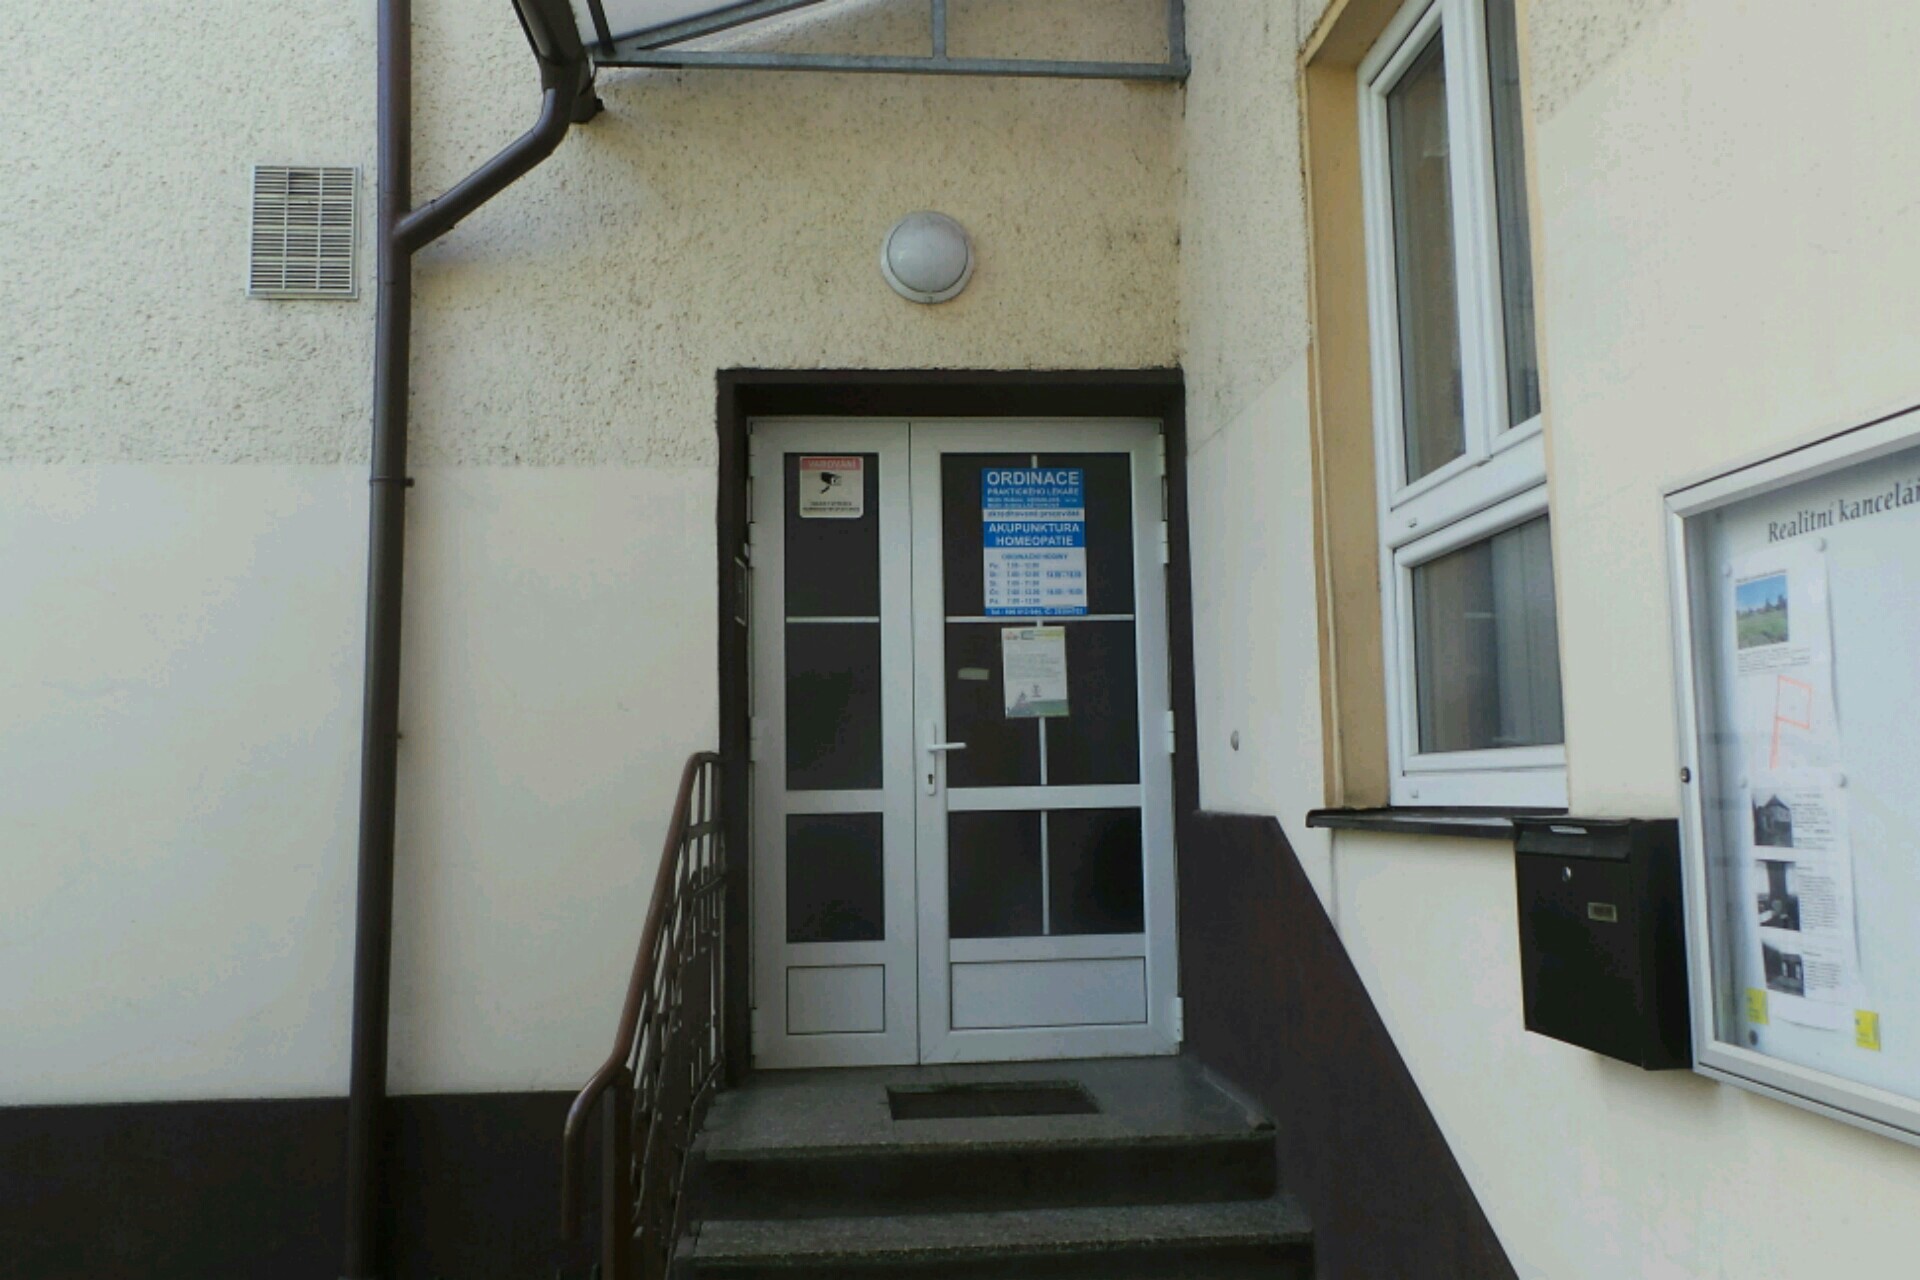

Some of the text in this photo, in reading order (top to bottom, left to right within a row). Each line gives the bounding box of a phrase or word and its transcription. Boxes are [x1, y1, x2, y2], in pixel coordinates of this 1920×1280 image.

[987, 471, 1079, 485] ORDINACE
[989, 523, 1080, 533] AKUPUNKTURA
[1767, 501, 1834, 543] Realitní
[996, 536, 1073, 546] HOMEOPATIE
